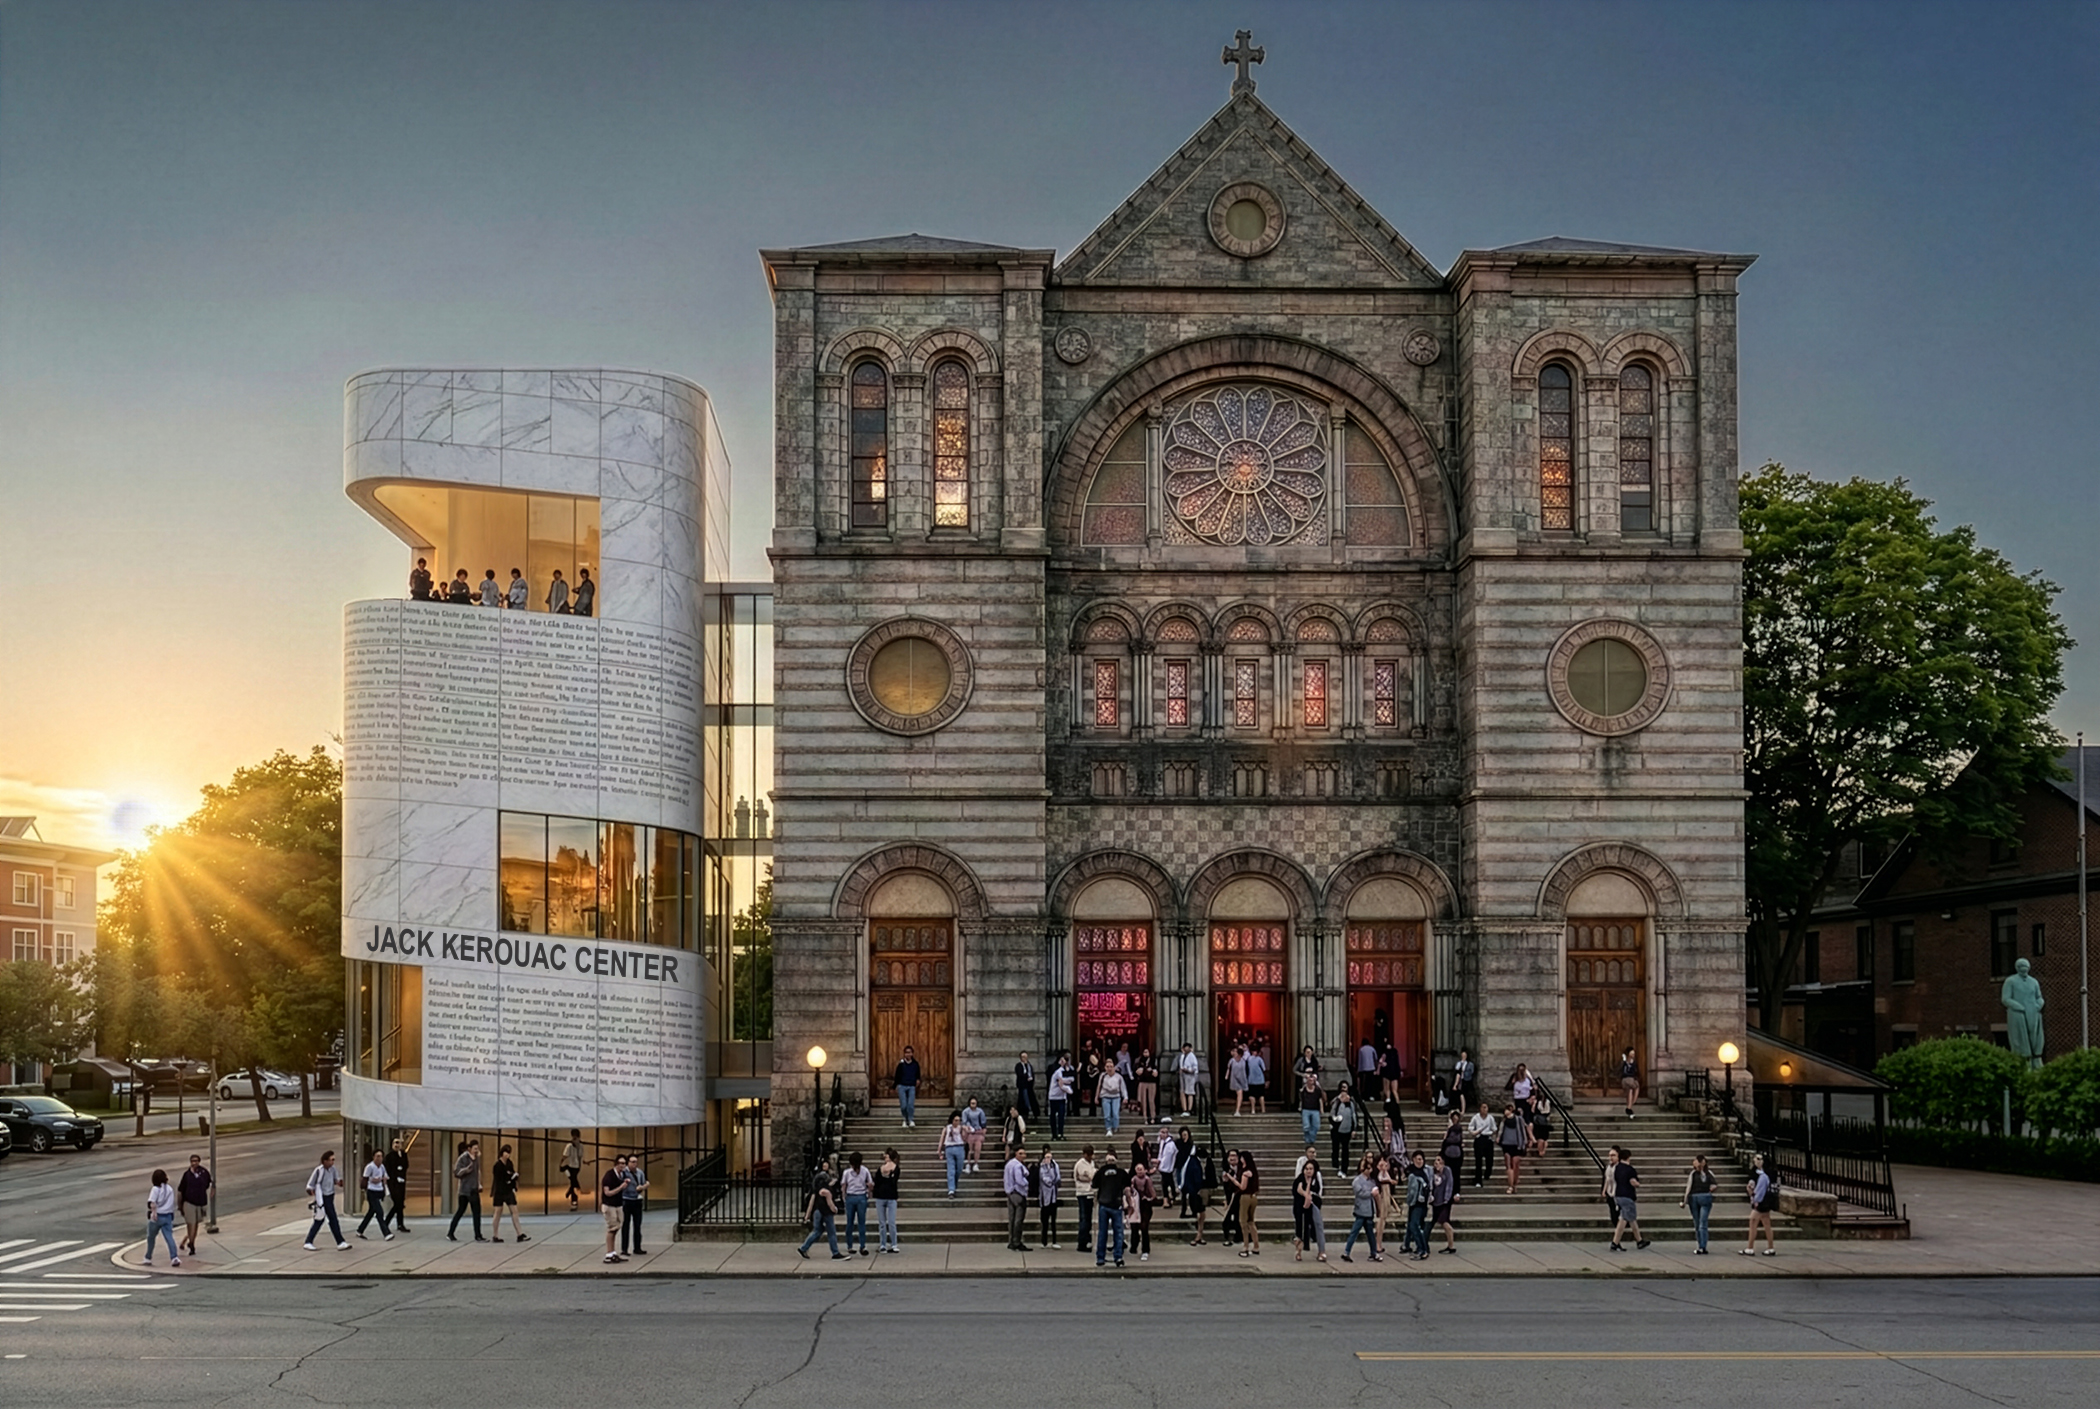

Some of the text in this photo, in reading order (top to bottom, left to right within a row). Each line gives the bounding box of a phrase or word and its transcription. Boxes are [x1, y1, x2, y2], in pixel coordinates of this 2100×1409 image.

[366, 925, 678, 983] JACK KEROUAC CENTER
